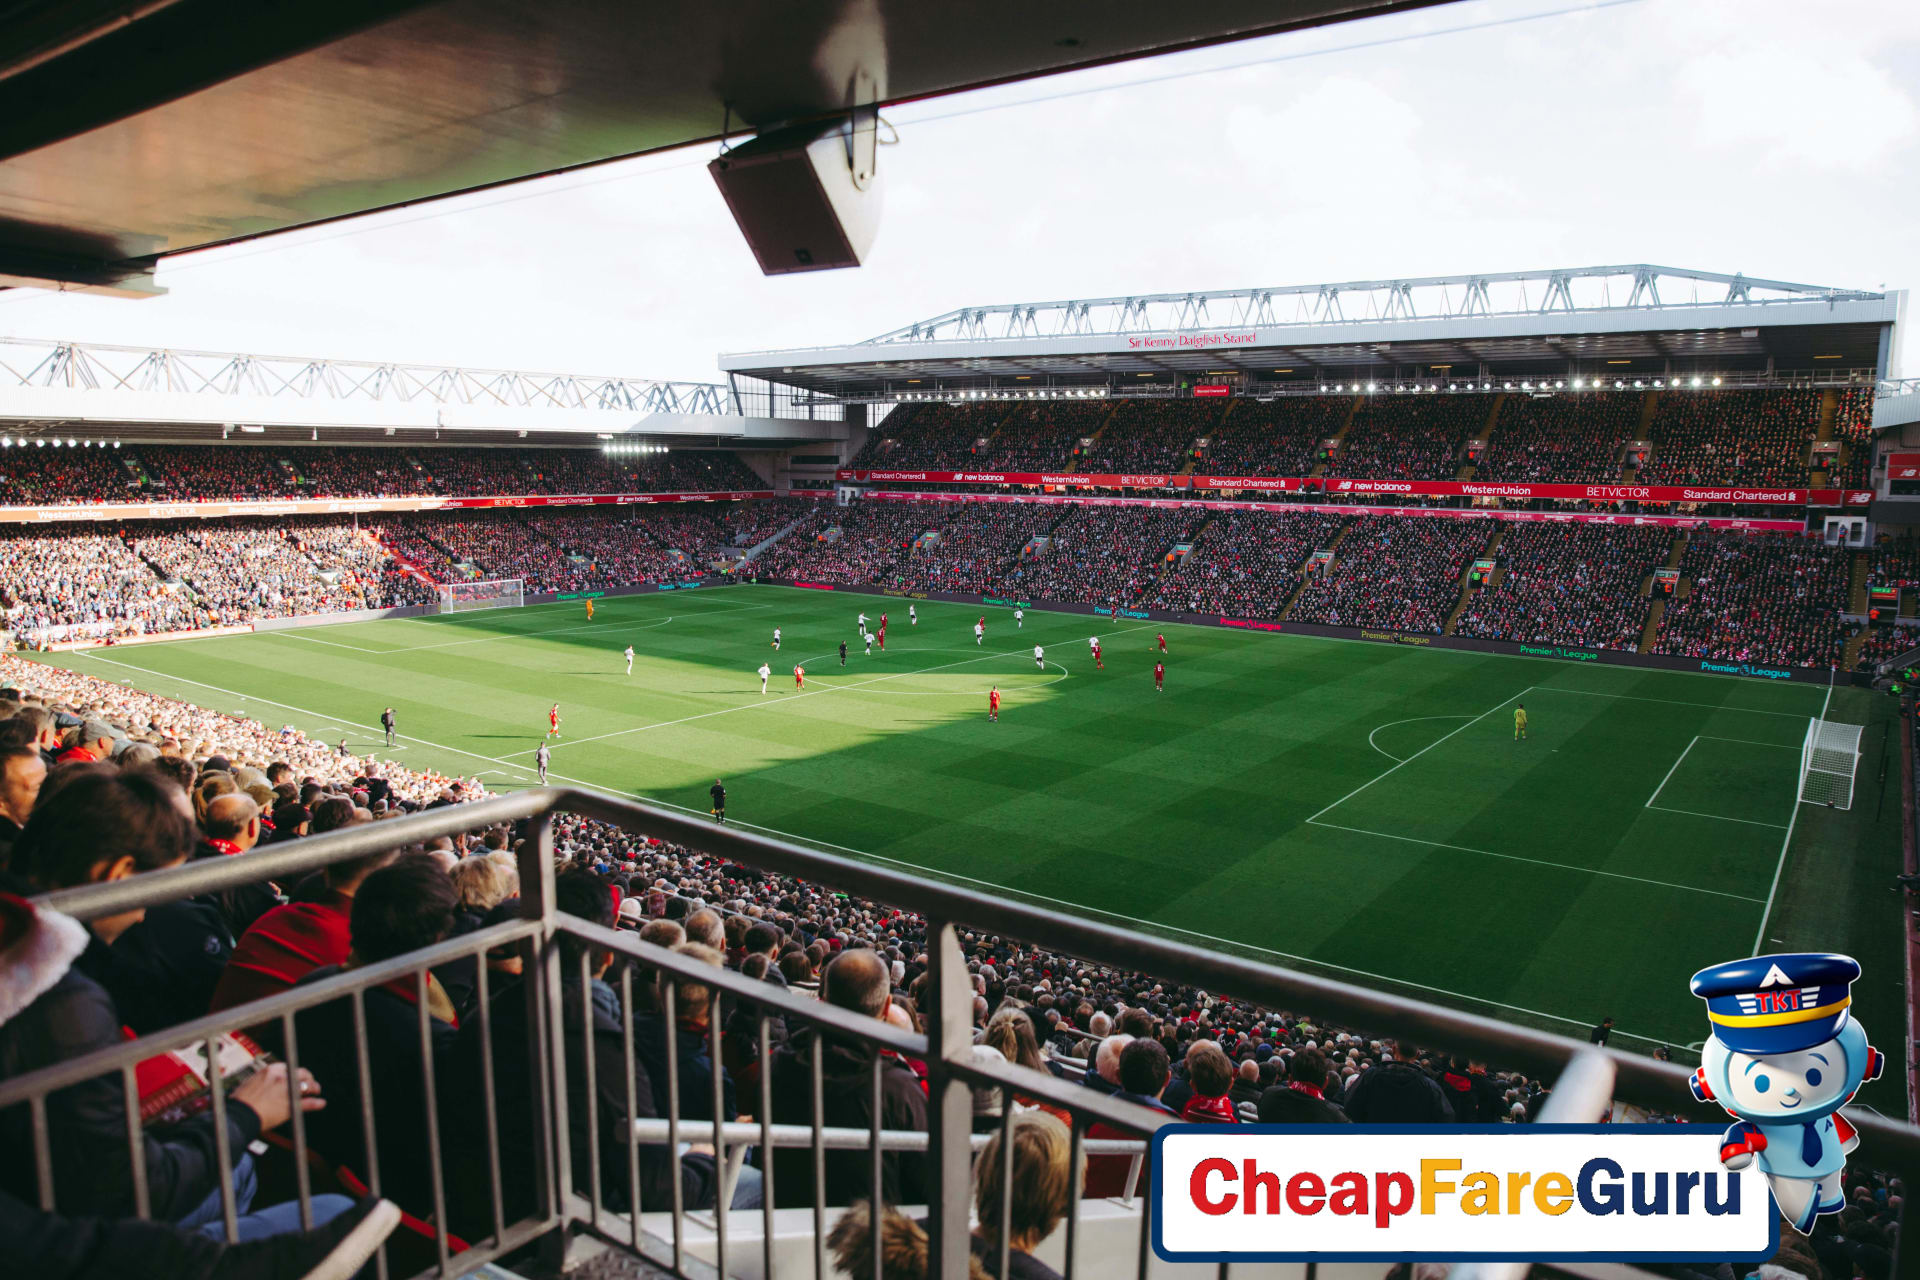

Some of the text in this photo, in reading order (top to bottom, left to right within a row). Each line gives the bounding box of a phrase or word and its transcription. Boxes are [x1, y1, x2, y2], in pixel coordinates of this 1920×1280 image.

[1129, 332, 1257, 348] Sir Kenny Dalglish Stand
[871, 472, 895, 480] Standard
[978, 473, 1005, 482] balance
[1041, 475, 1090, 484] WesternUnion
[1121, 475, 1165, 485] BETVICTOR
[1209, 478, 1279, 488] Standard Chartered
[1354, 481, 1412, 491] new balance
[1462, 484, 1531, 495] WesternUnion
[1586, 486, 1650, 497] BETVICTOR
[1683, 489, 1787, 501] Standard Chartered
[1125, 609, 1150, 619] League
[1361, 630, 1430, 644] Premier League
[1520, 645, 1597, 661] Premier League
[1701, 661, 1791, 679] Premier League
